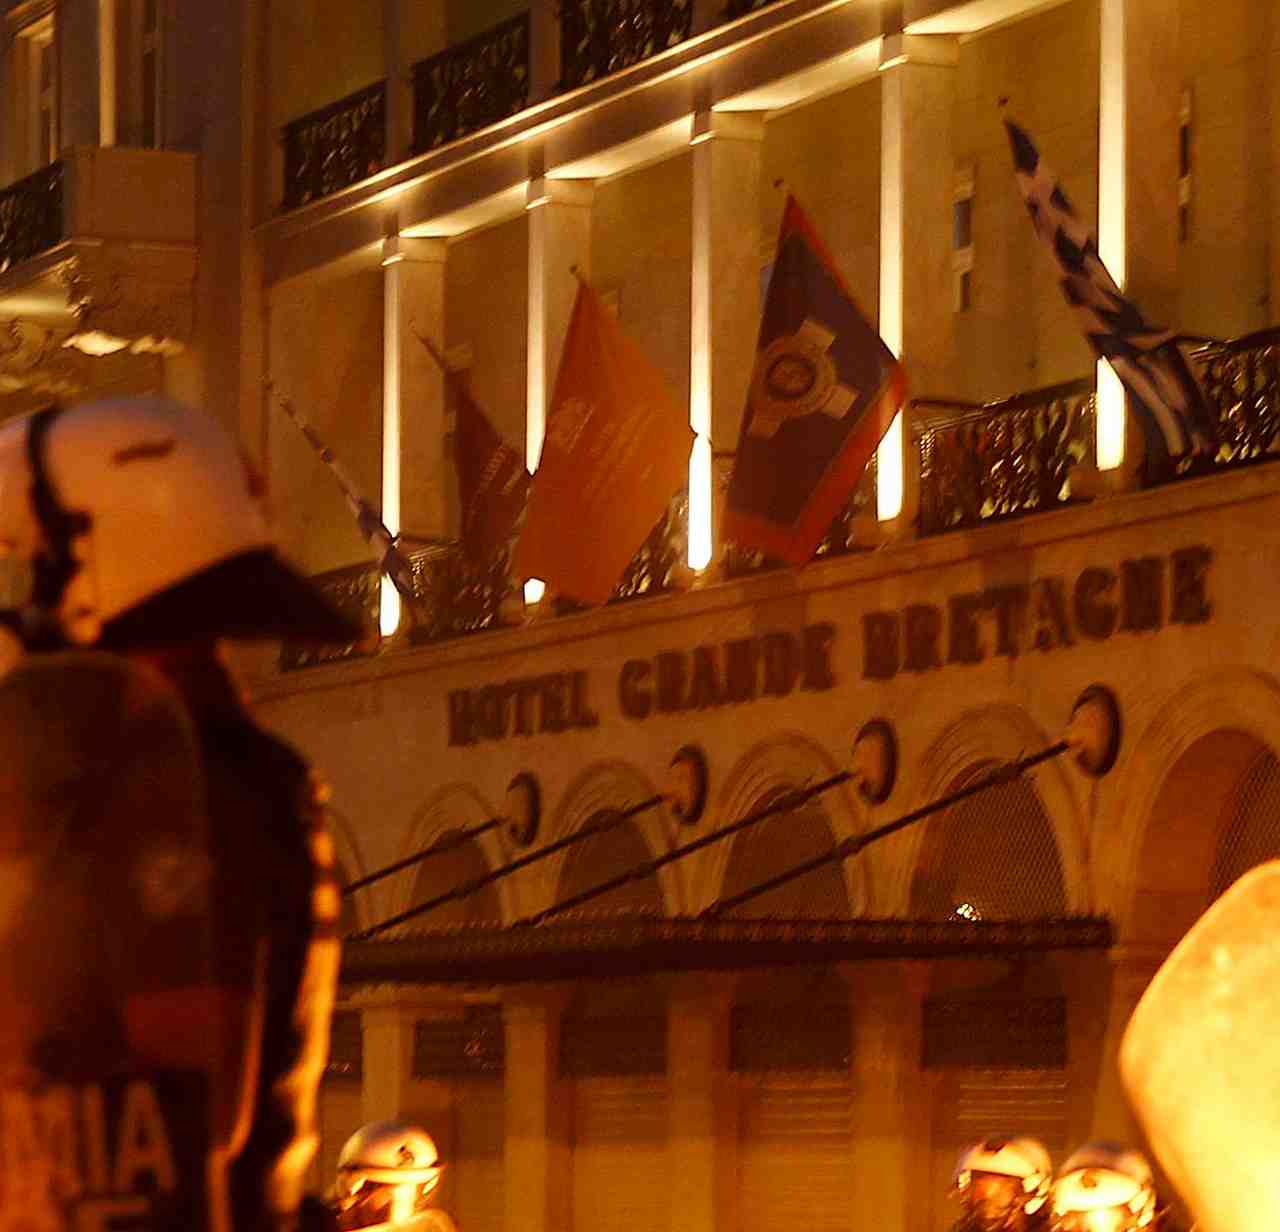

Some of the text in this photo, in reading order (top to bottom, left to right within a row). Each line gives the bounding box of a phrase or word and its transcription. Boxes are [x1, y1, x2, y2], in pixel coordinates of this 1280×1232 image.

[448, 542, 1216, 748] HOTEL GRANDE BRETAGNE
